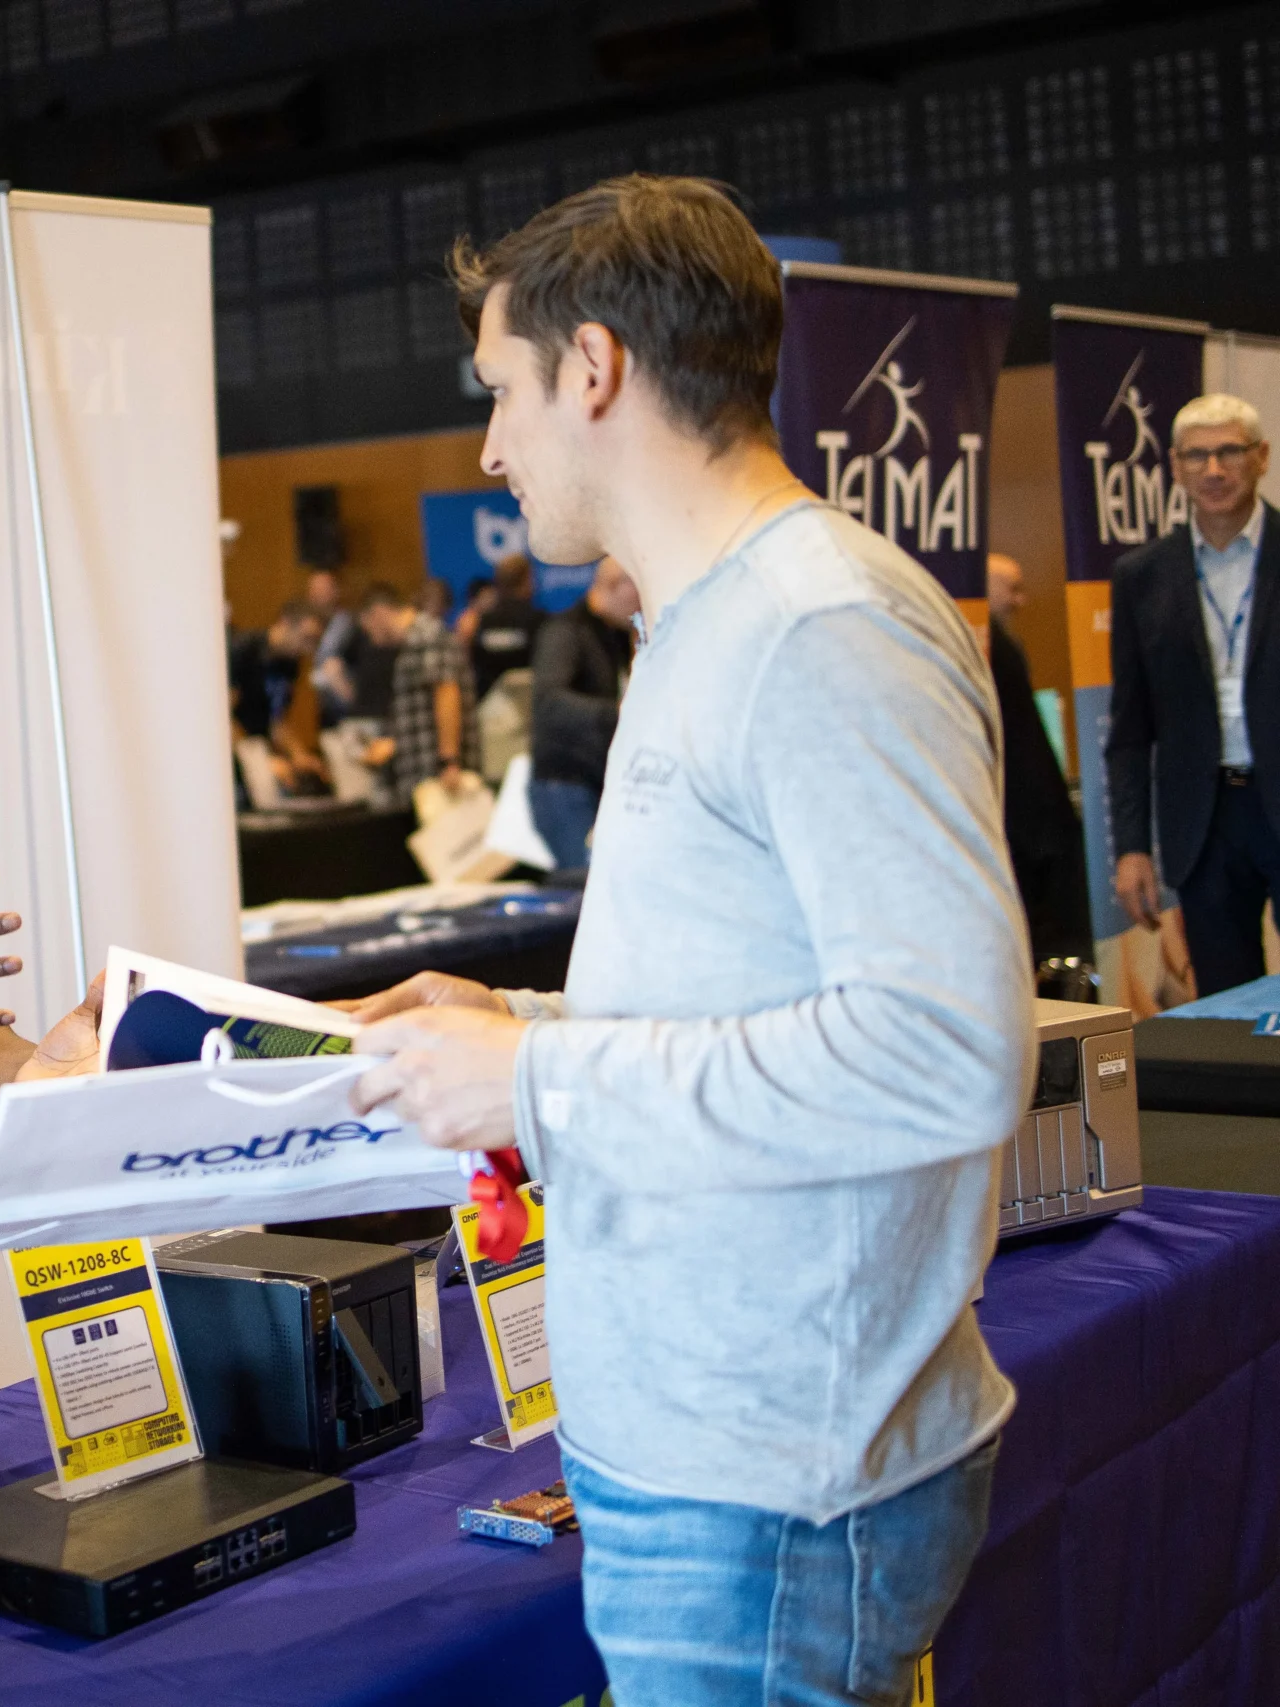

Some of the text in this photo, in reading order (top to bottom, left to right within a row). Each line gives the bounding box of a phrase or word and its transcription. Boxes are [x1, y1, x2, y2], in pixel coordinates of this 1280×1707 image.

[121, 1121, 402, 1172] brother
[462, 1212, 480, 1223] QNA
[25, 1246, 131, 1287] QSW-1208-8C
[144, 1412, 179, 1430] COMPUTING
